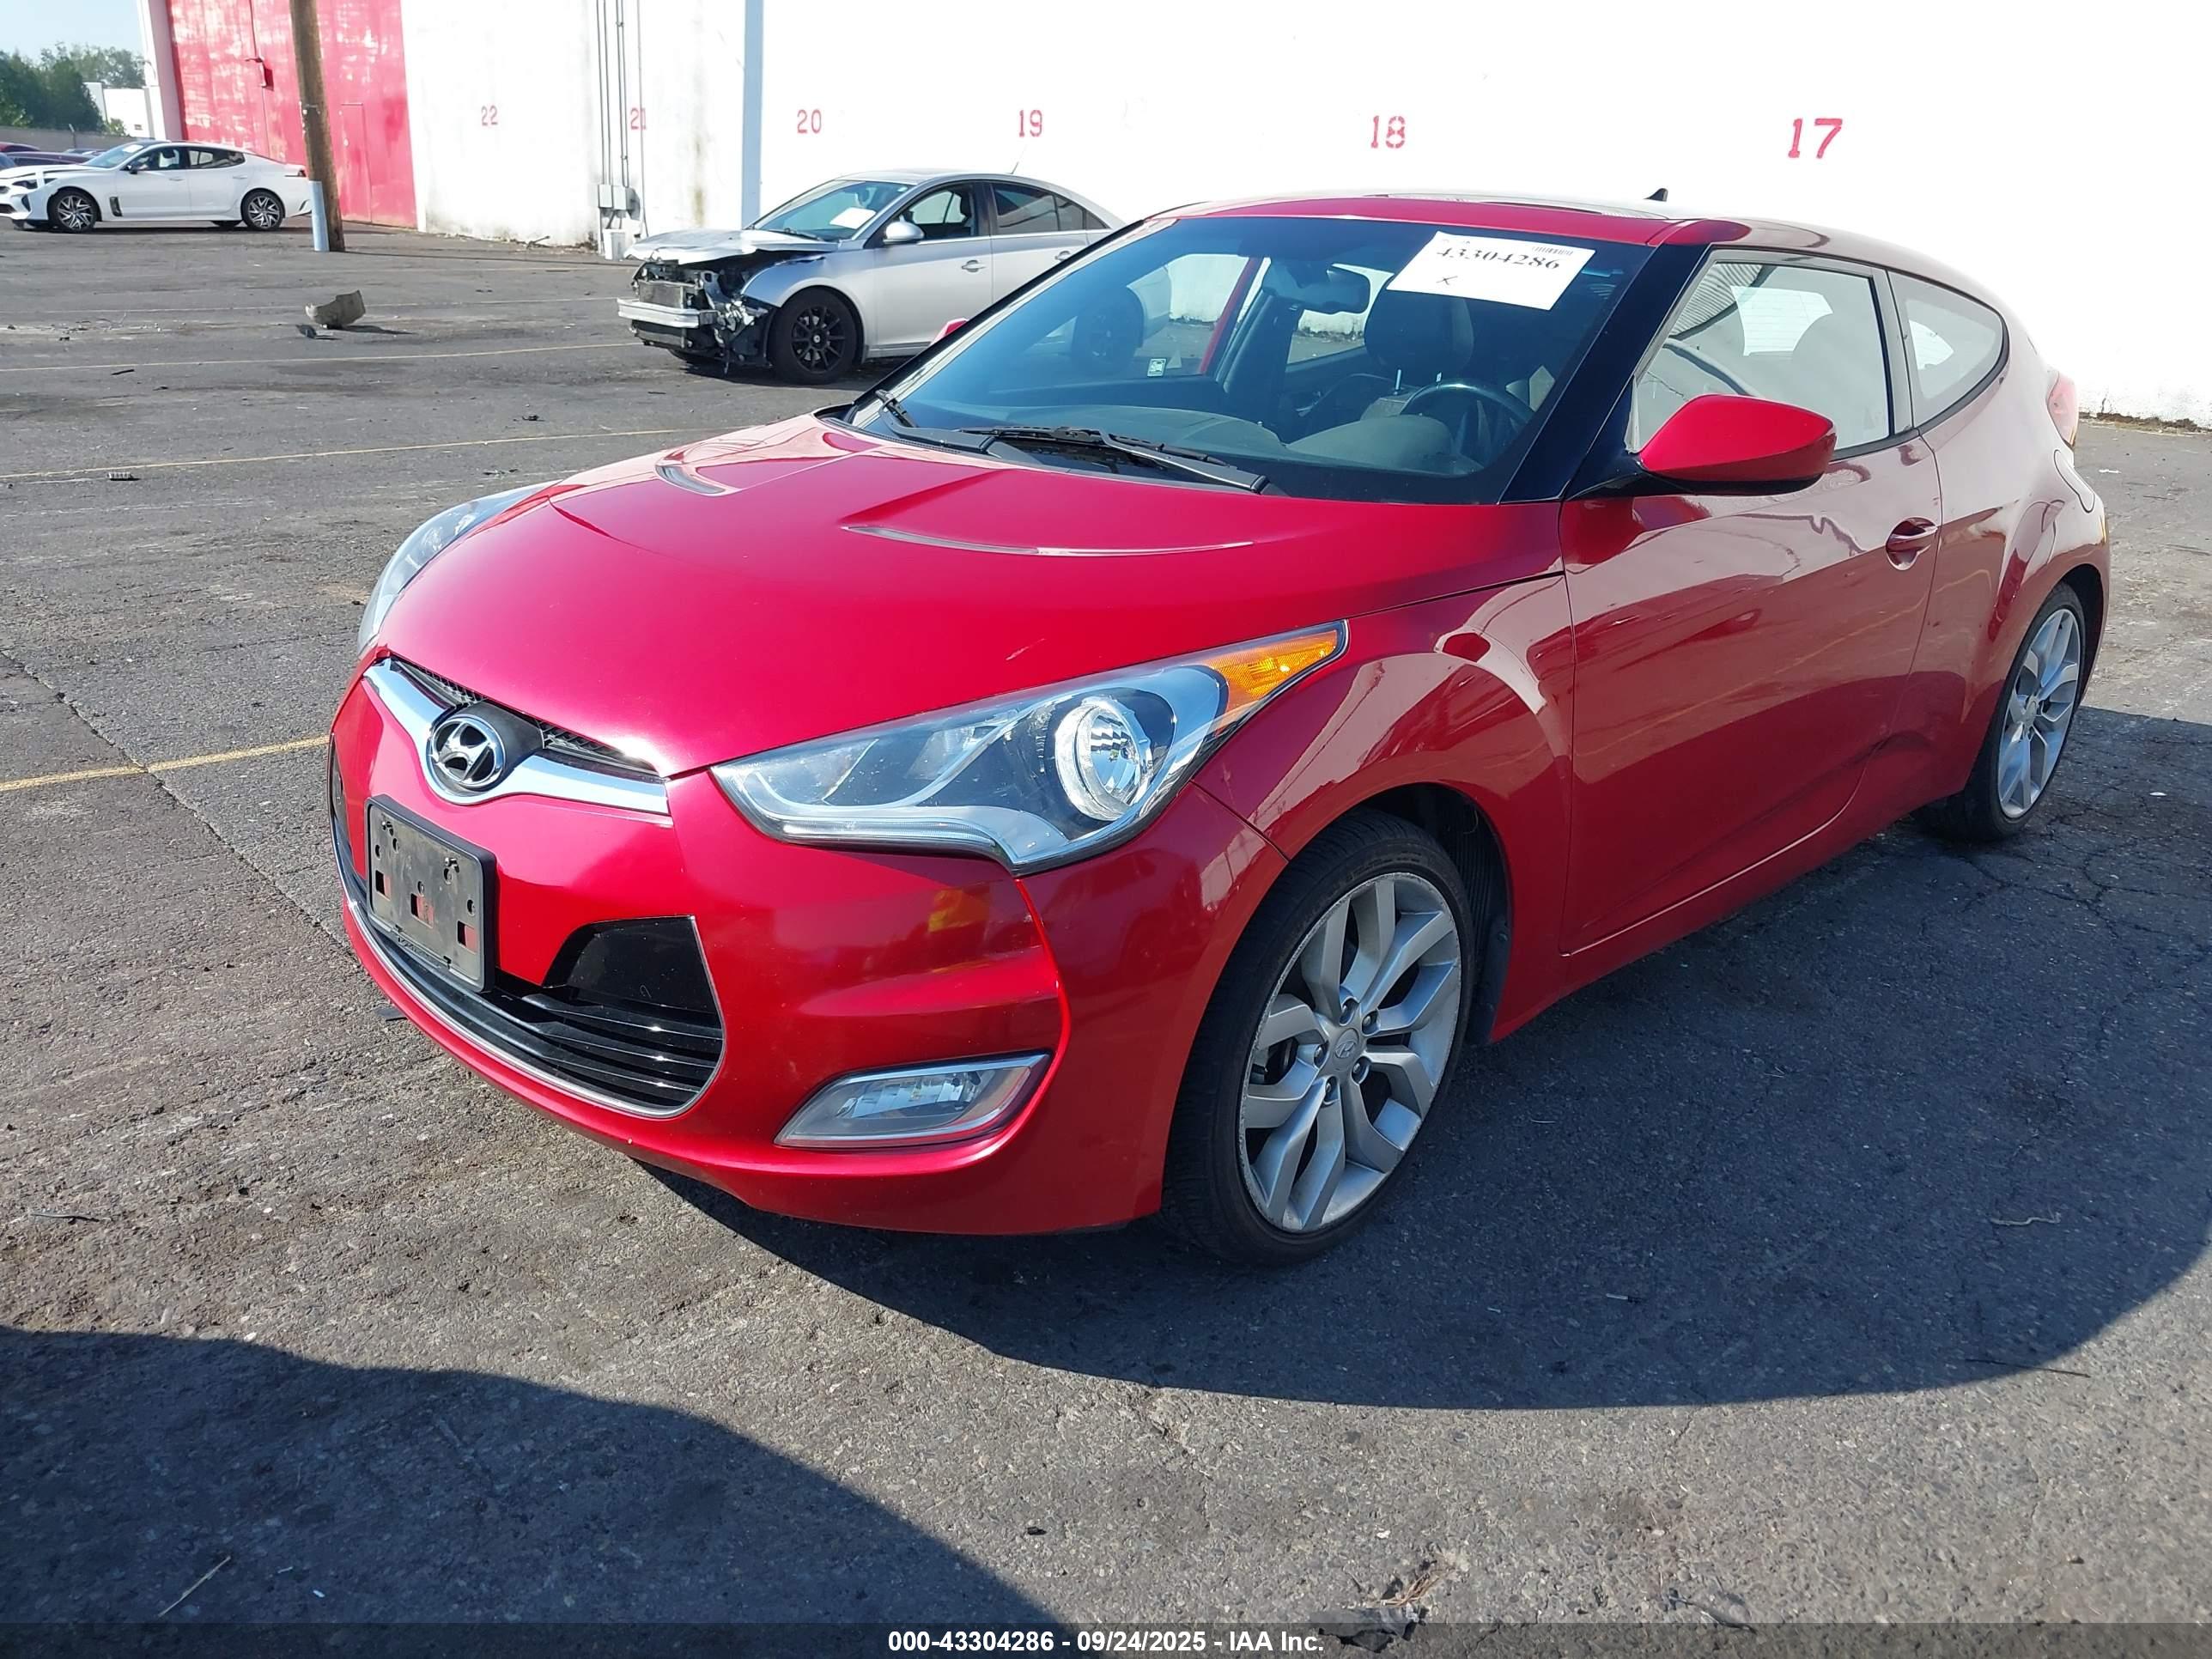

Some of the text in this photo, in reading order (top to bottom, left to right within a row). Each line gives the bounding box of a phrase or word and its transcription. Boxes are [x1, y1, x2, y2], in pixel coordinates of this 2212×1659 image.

[481, 105, 498, 126] 22
[630, 107, 647, 130] 21
[796, 109, 822, 135] 20
[1018, 109, 1043, 138] 19
[1370, 115, 1407, 150] 18
[1787, 117, 1844, 160] 17
[1437, 246, 1561, 270] 43304286
